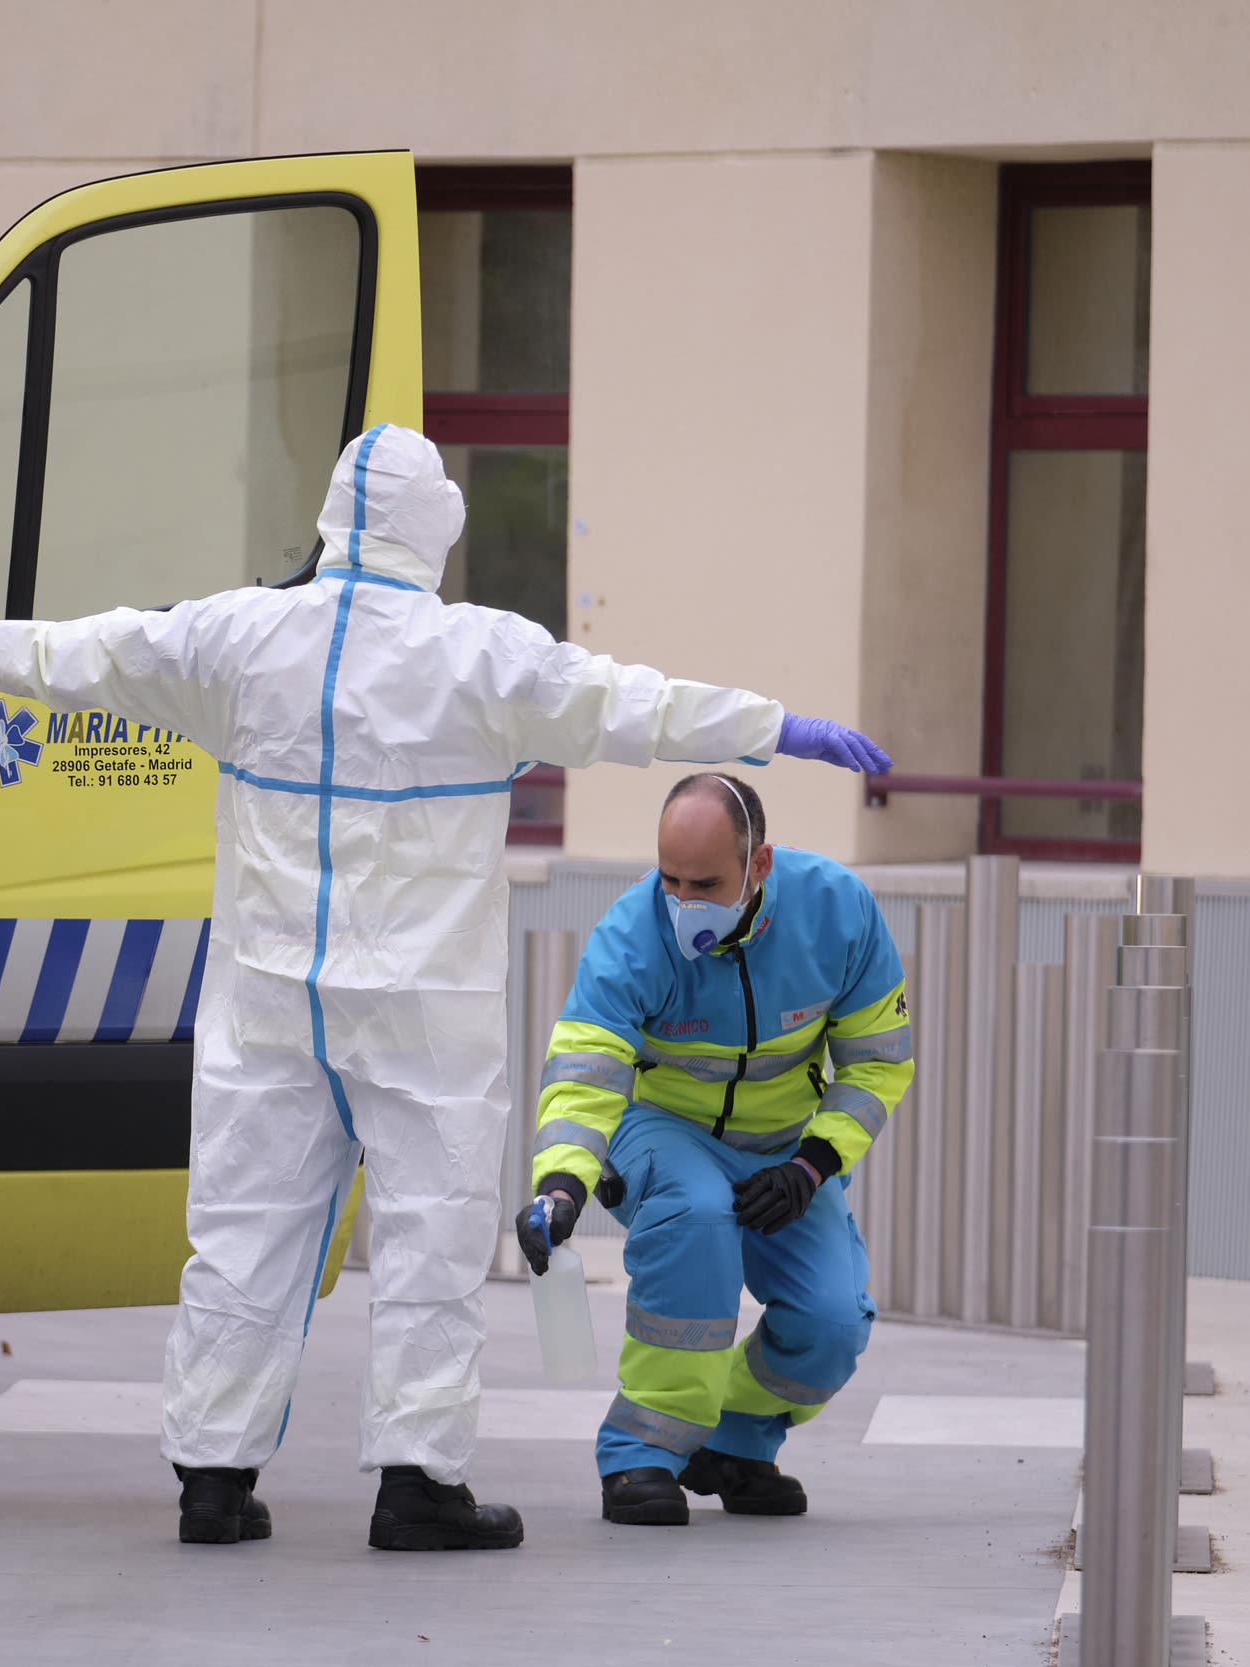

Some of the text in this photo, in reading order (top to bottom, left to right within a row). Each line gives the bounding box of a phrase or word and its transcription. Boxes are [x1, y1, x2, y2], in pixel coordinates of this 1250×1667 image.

[46, 712, 128, 743] MARIA
[74, 744, 170, 758] Impresores, 42
[52, 760, 90, 772] 28906
[94, 760, 136, 771] Getafe
[148, 758, 193, 770] Madrid
[68, 774, 177, 787] Tel.: 91 680 43 57
